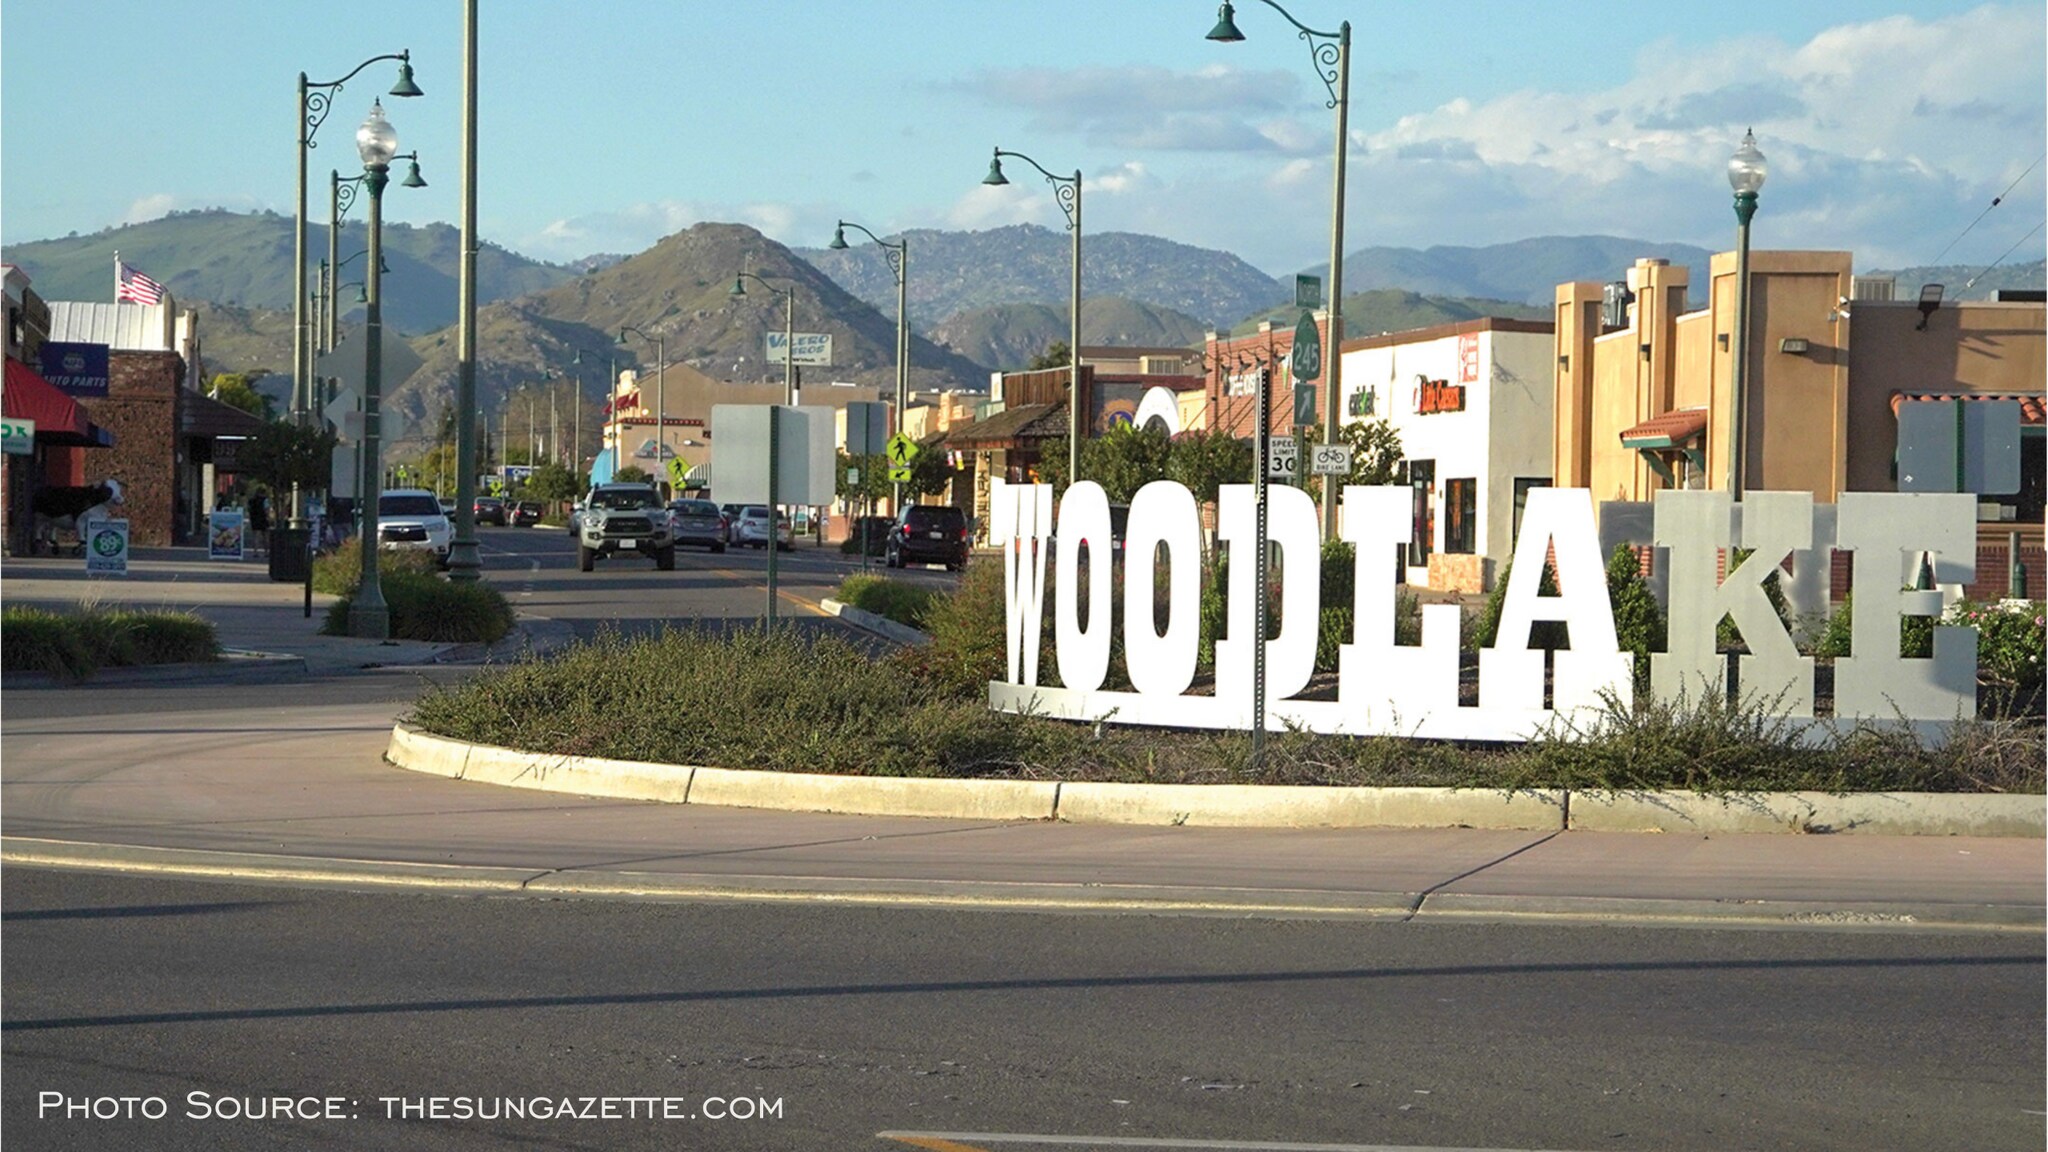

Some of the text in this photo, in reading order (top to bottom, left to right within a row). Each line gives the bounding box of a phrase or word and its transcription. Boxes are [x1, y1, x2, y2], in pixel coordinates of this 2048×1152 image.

[1294, 342, 1319, 372] 245
[72, 376, 107, 388] PARTS
[998, 480, 1978, 720] WOODLAKE
